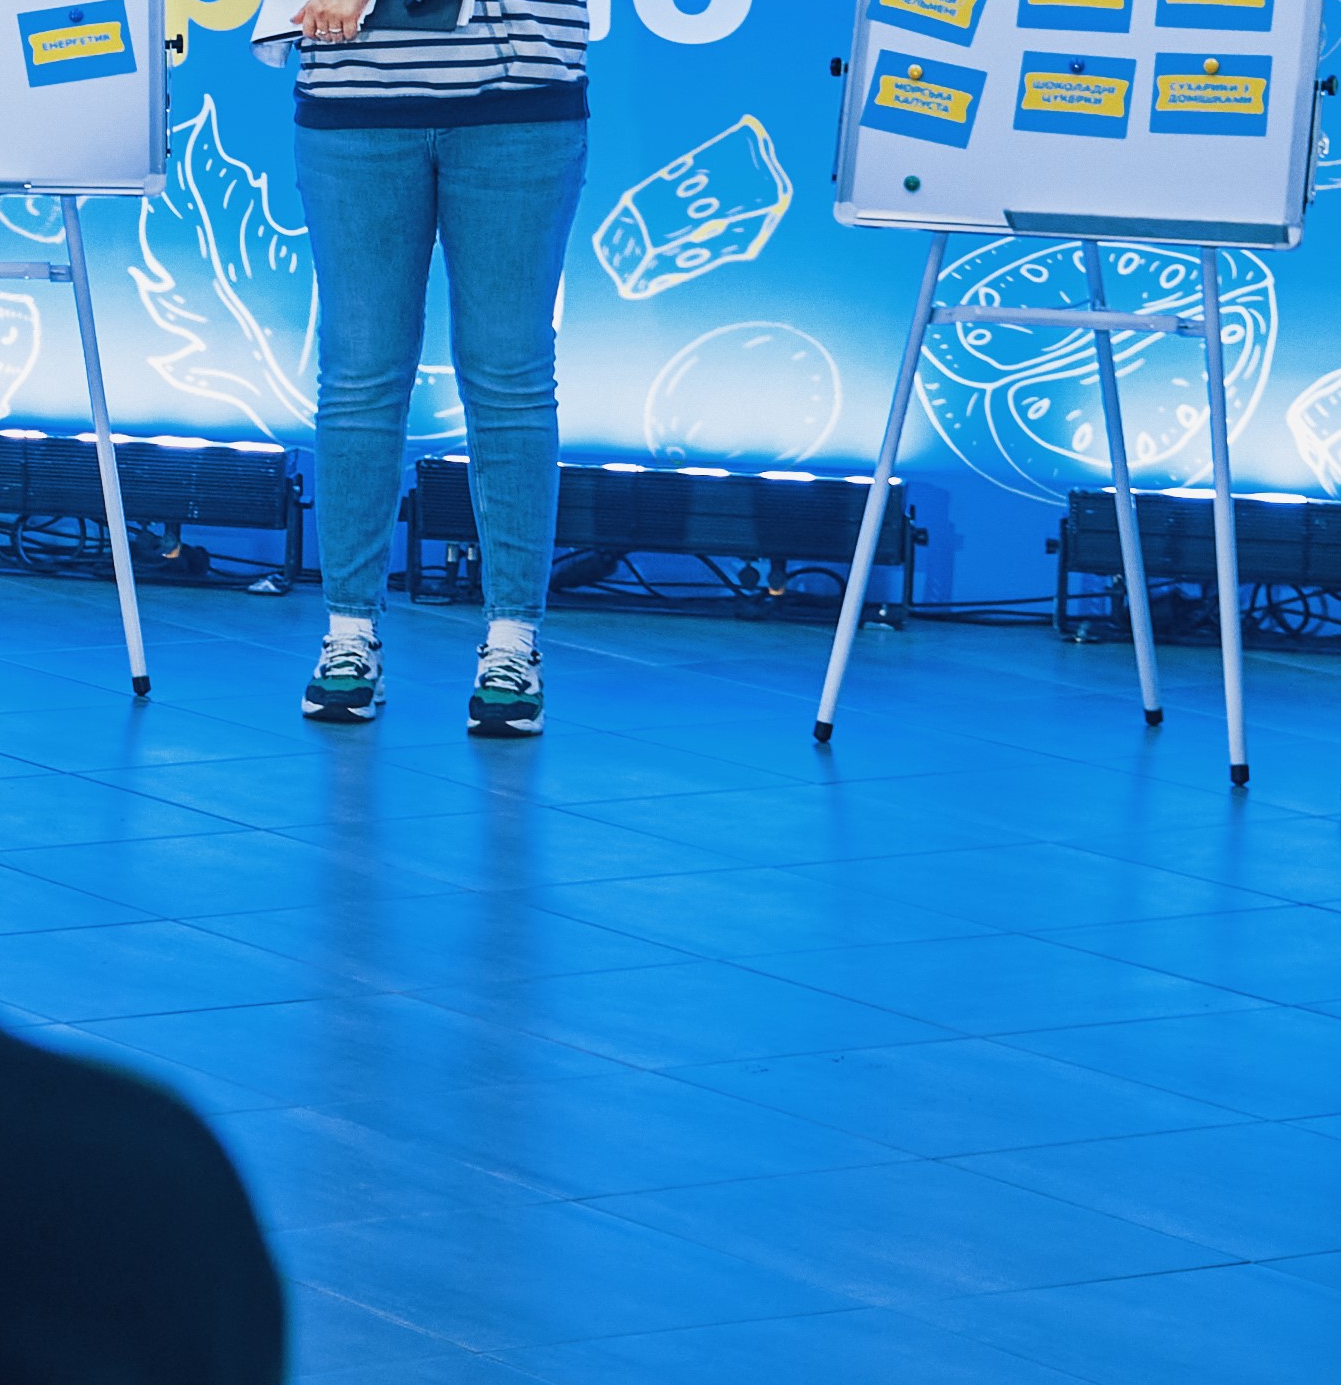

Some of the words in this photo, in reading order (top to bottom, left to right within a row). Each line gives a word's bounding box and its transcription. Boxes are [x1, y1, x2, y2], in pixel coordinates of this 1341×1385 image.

[41, 33, 111, 51] ЕНЕРГЕТИК
[894, 82, 953, 102] МОРСЬКА
[1032, 80, 1116, 94] ШОКОЛАДНІ
[893, 94, 950, 114] КАПУСТА
